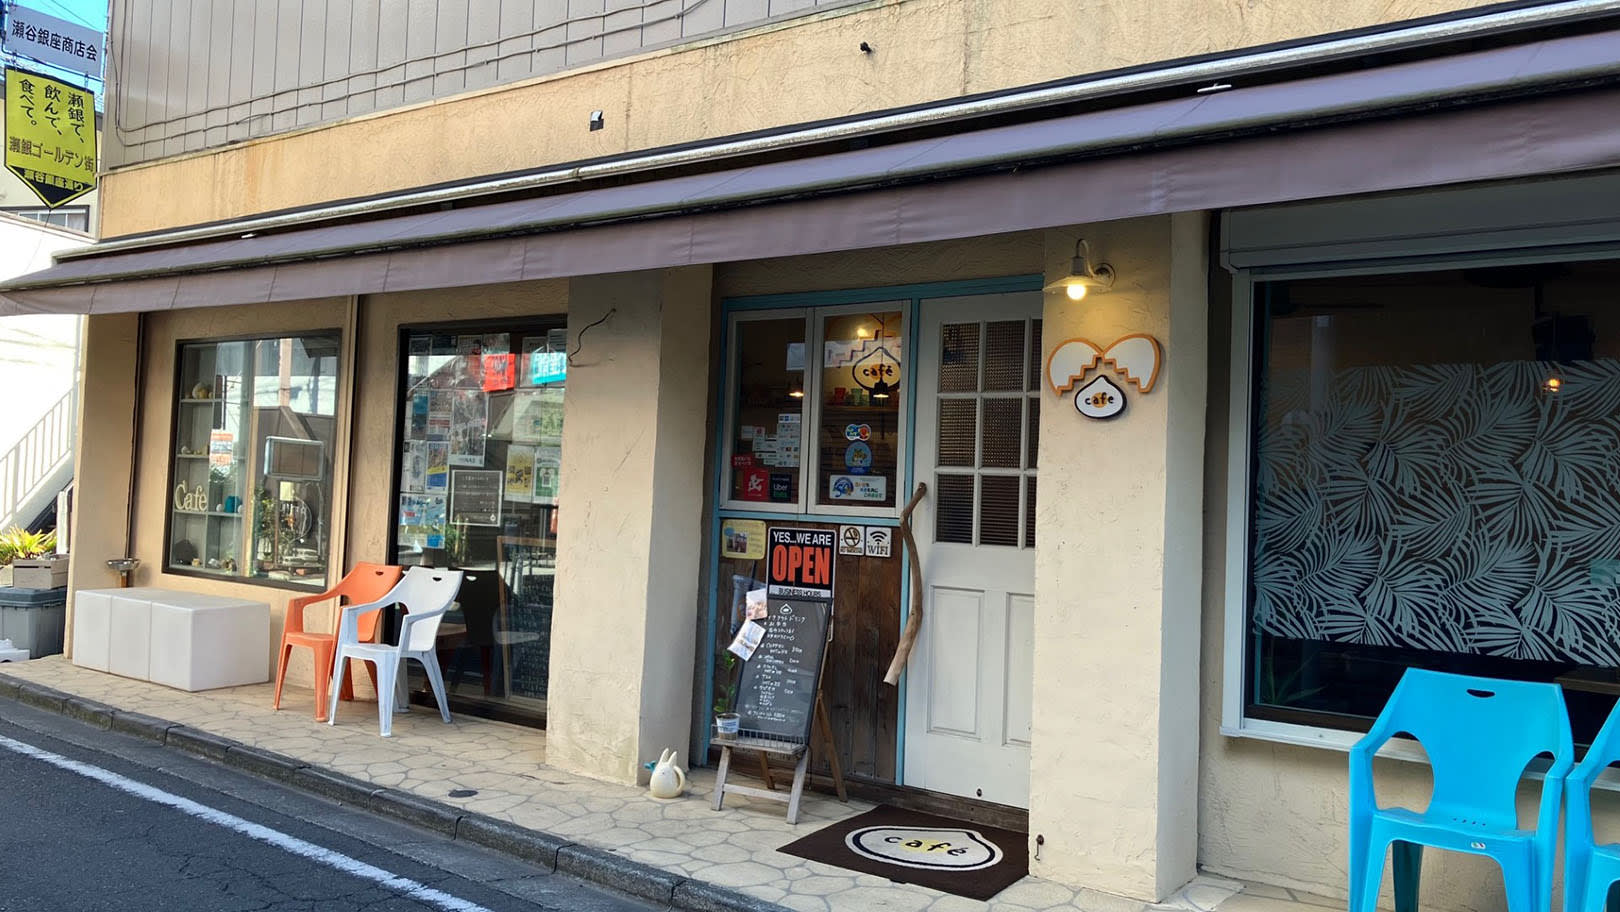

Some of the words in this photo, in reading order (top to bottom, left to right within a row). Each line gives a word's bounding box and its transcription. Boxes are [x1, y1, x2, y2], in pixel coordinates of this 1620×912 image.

[12, 19, 97, 62] 瀬谷銀座商店会
[19, 78, 38, 128] 食べて。
[174, 480, 208, 512] Cafe
[813, 534, 832, 546] ARE
[772, 544, 831, 585] OPEN
[883, 835, 969, 857] café
